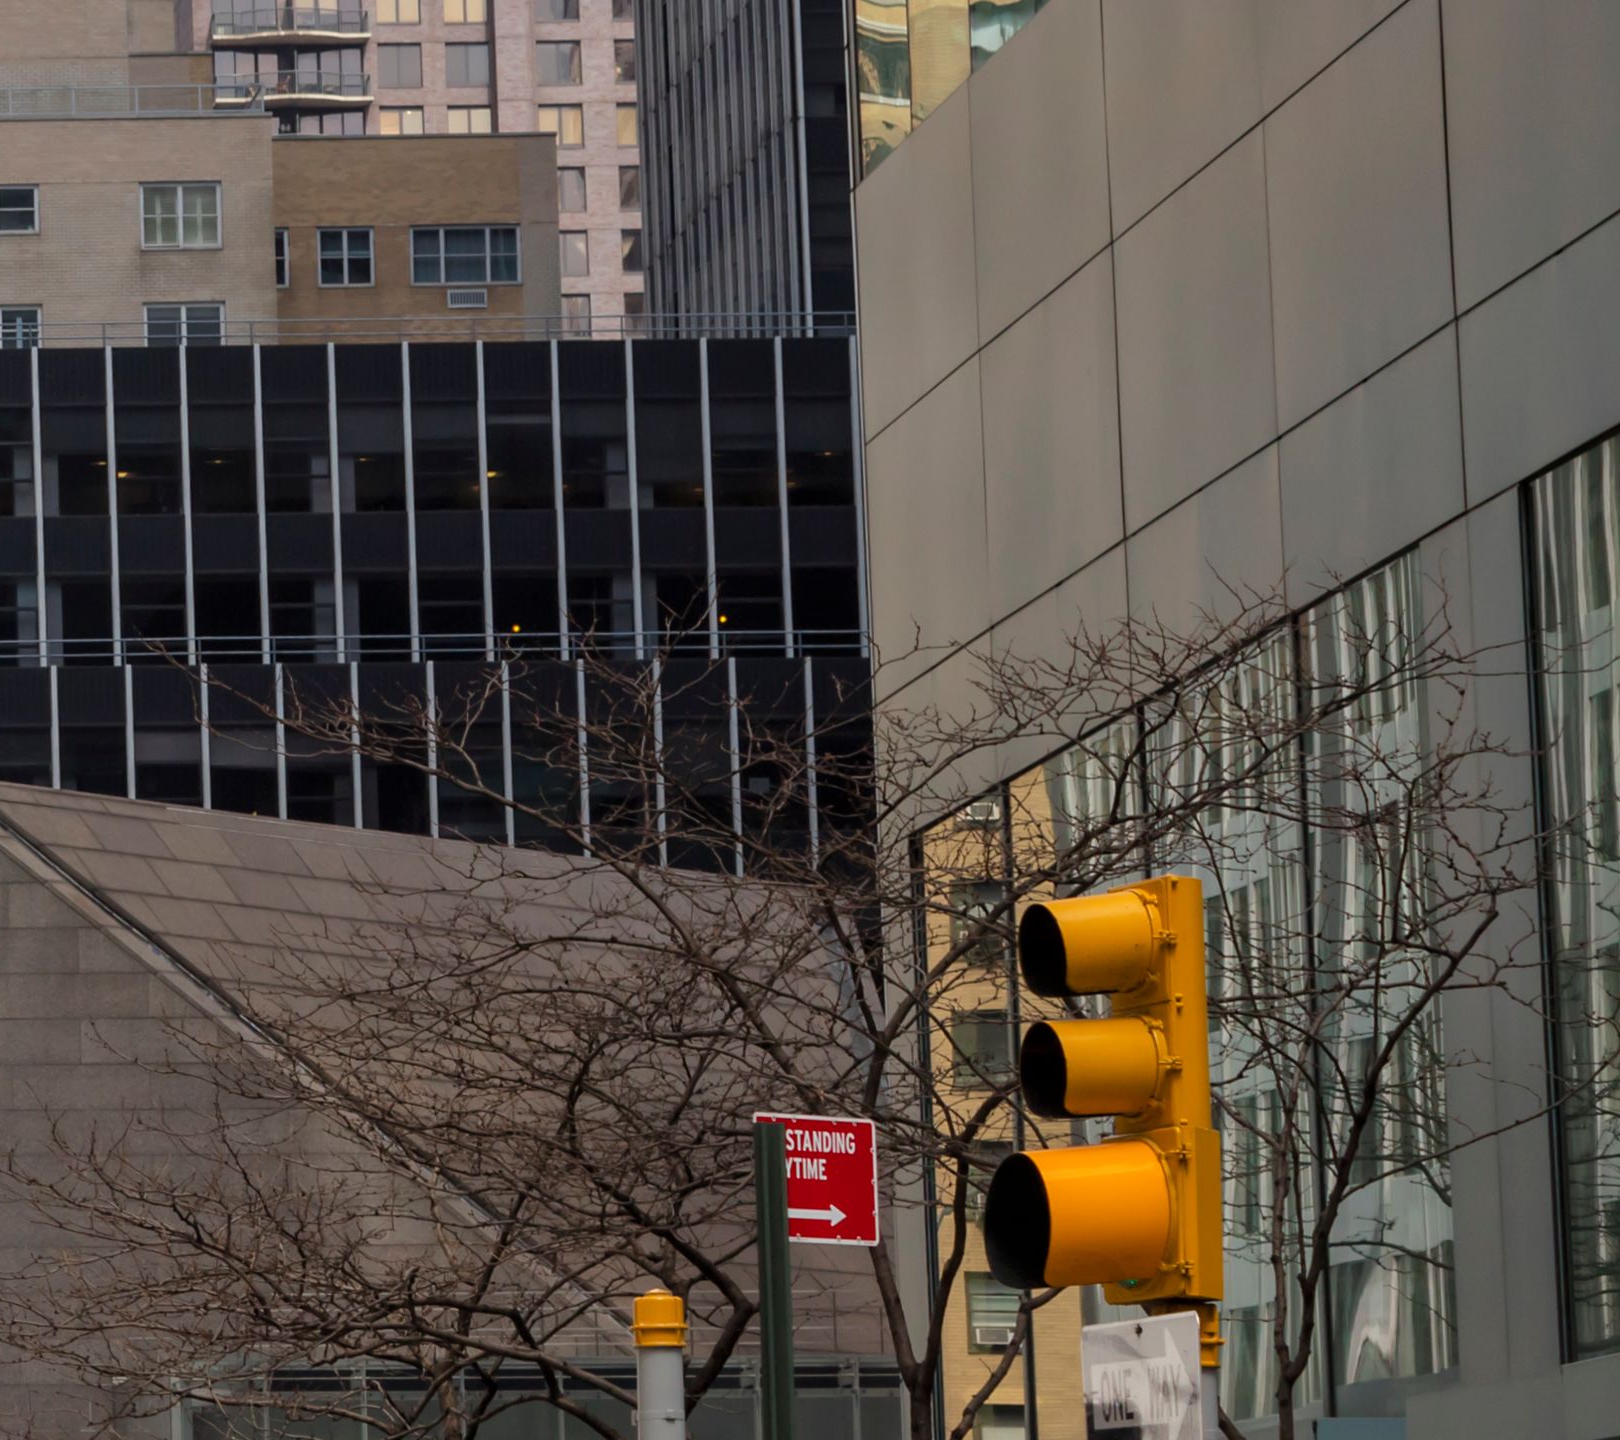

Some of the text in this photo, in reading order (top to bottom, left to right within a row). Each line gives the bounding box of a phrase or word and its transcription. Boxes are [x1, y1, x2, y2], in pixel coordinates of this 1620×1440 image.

[785, 1128, 856, 1154] STANDING
[785, 1157, 827, 1180] YTIME
[1100, 1364, 1181, 1423] ONE WAY
